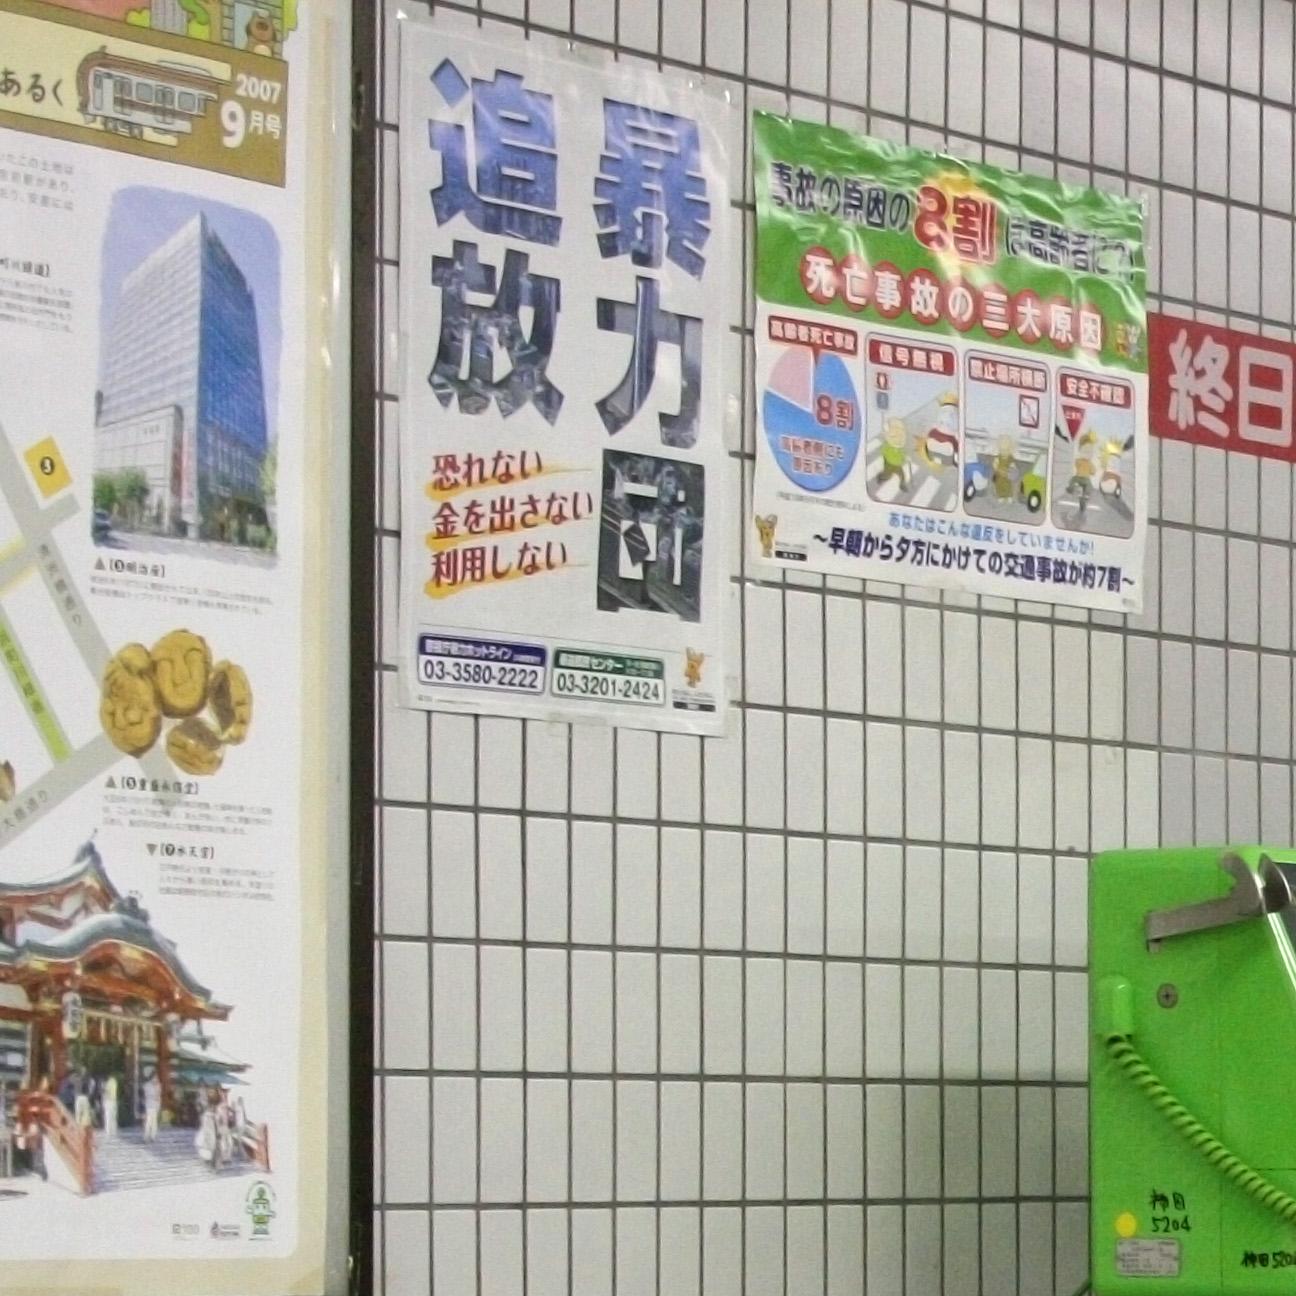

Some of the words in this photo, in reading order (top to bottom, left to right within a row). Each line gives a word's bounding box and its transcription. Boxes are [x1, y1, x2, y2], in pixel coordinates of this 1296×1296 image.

[235, 73, 281, 104] 2007
[220, 100, 283, 148] 9月号
[429, 56, 564, 428] 追放
[805, 253, 1103, 352] 死亡事故の三大原因
[594, 97, 711, 624] 暴力団
[815, 393, 856, 432] 8割
[432, 450, 543, 491] 恐れない
[432, 491, 593, 540] 金を出さない
[431, 541, 567, 588] 利用しない
[423, 659, 539, 690] 03-3580-2222
[556, 671, 660, 701] 03-3201-2424
[1151, 1215, 1192, 1234] 5204
